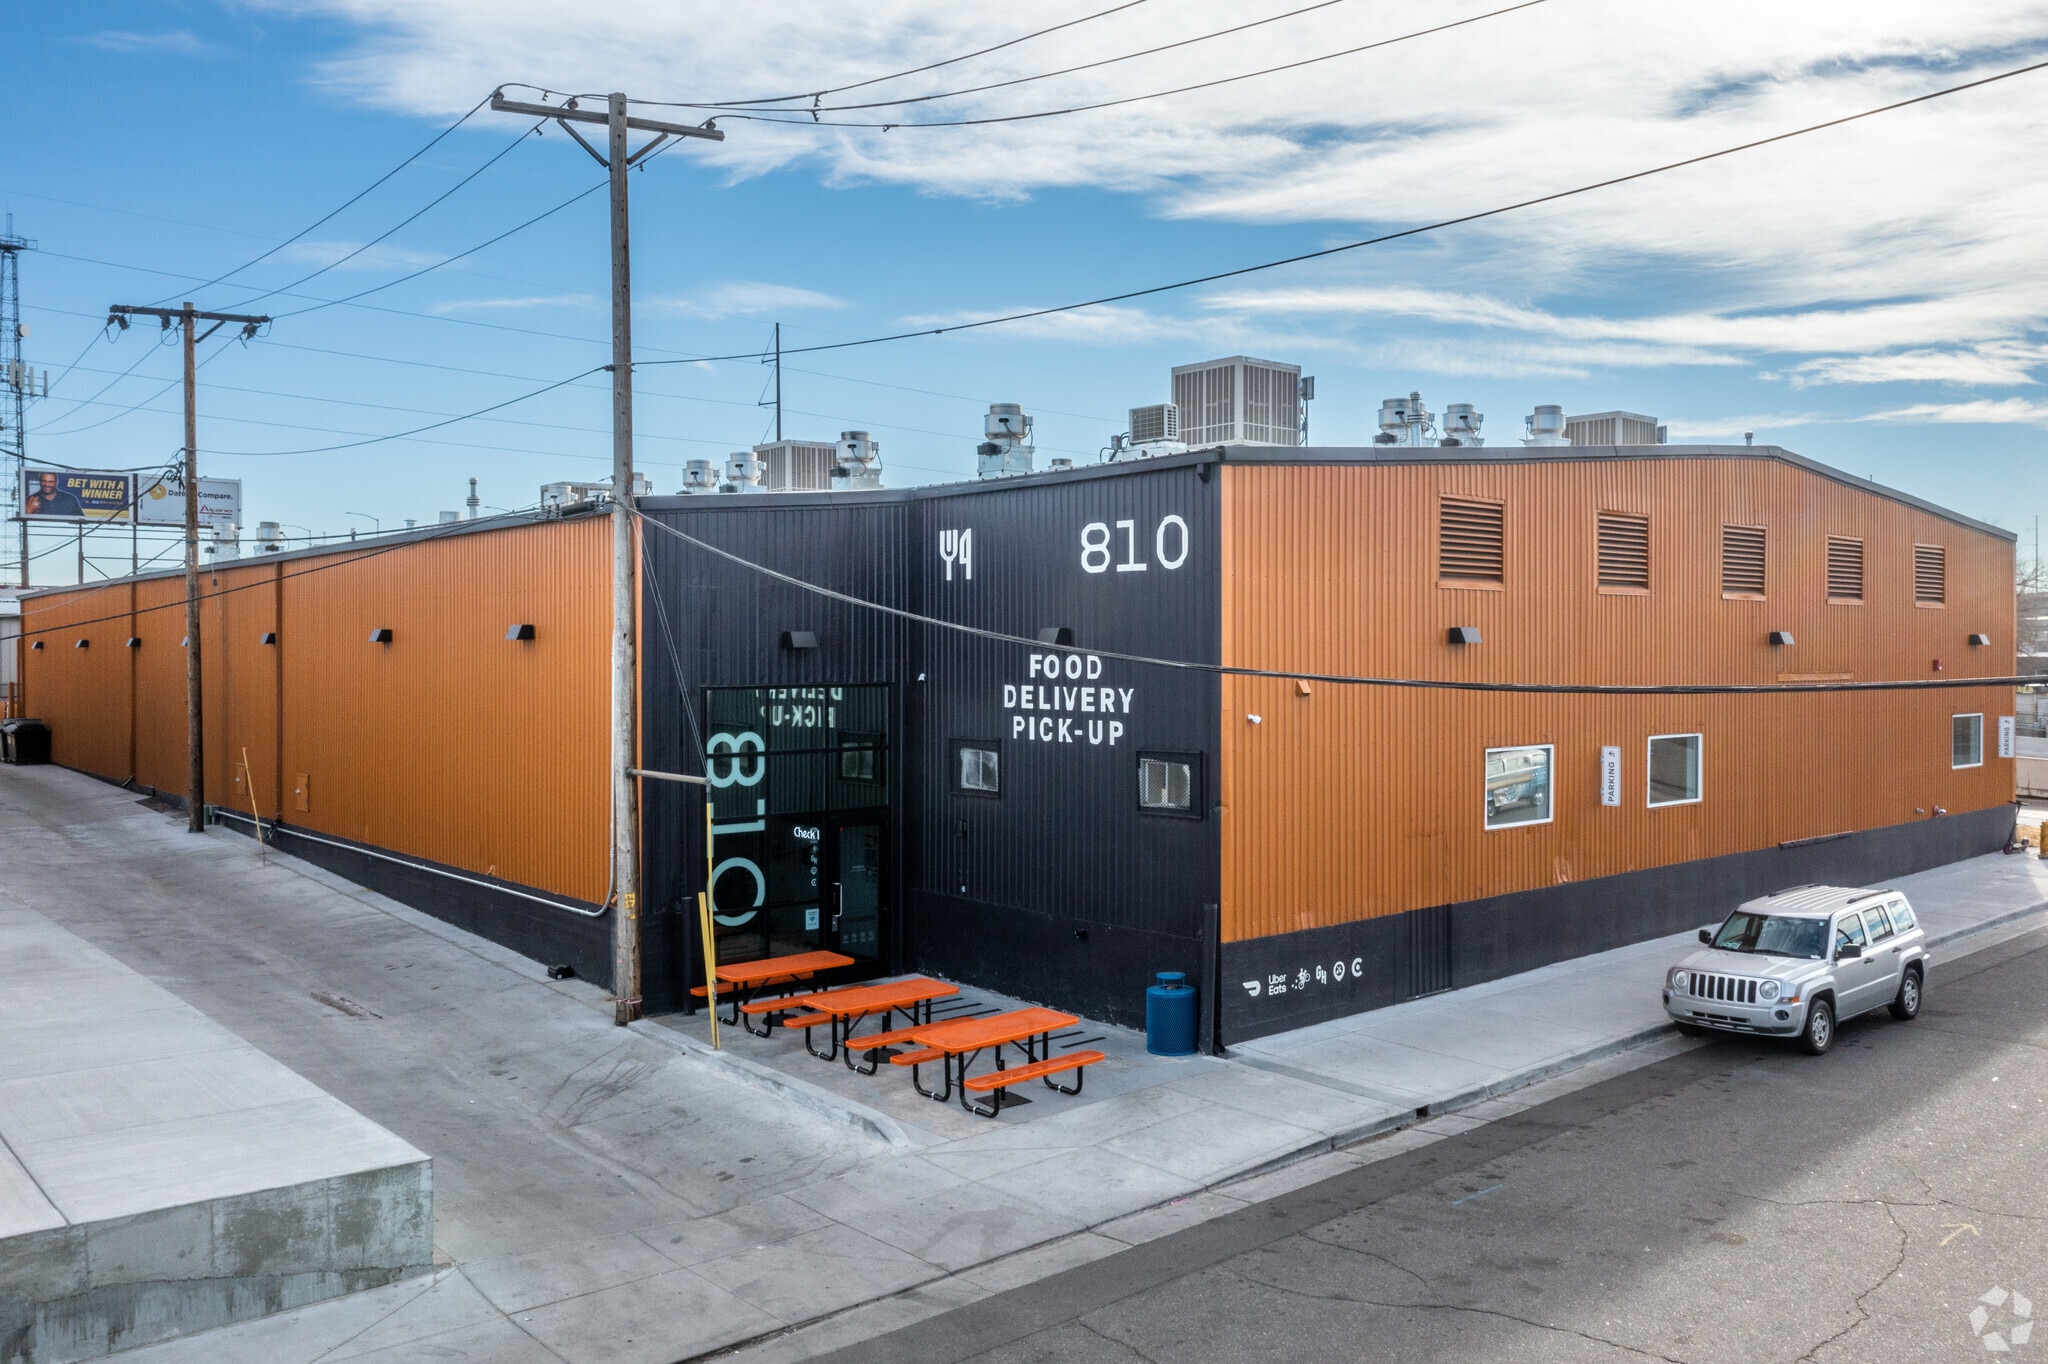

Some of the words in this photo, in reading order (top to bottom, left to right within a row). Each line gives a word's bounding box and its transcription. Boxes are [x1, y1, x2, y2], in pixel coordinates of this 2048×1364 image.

[67, 478, 88, 488] BET
[89, 479, 116, 489] WITH
[117, 481, 125, 490] A
[81, 489, 123, 499] WINNER
[198, 491, 233, 500] Compare.
[1081, 514, 1189, 573] 810
[1029, 654, 1102, 679] FOOD
[1003, 684, 1135, 713] DELIVERY
[1012, 715, 1124, 745] PICK-UP
[706, 731, 765, 927] 810
[793, 826, 816, 840] Check
[1268, 974, 1287, 985] Uber
[1268, 984, 1287, 996] Eats
